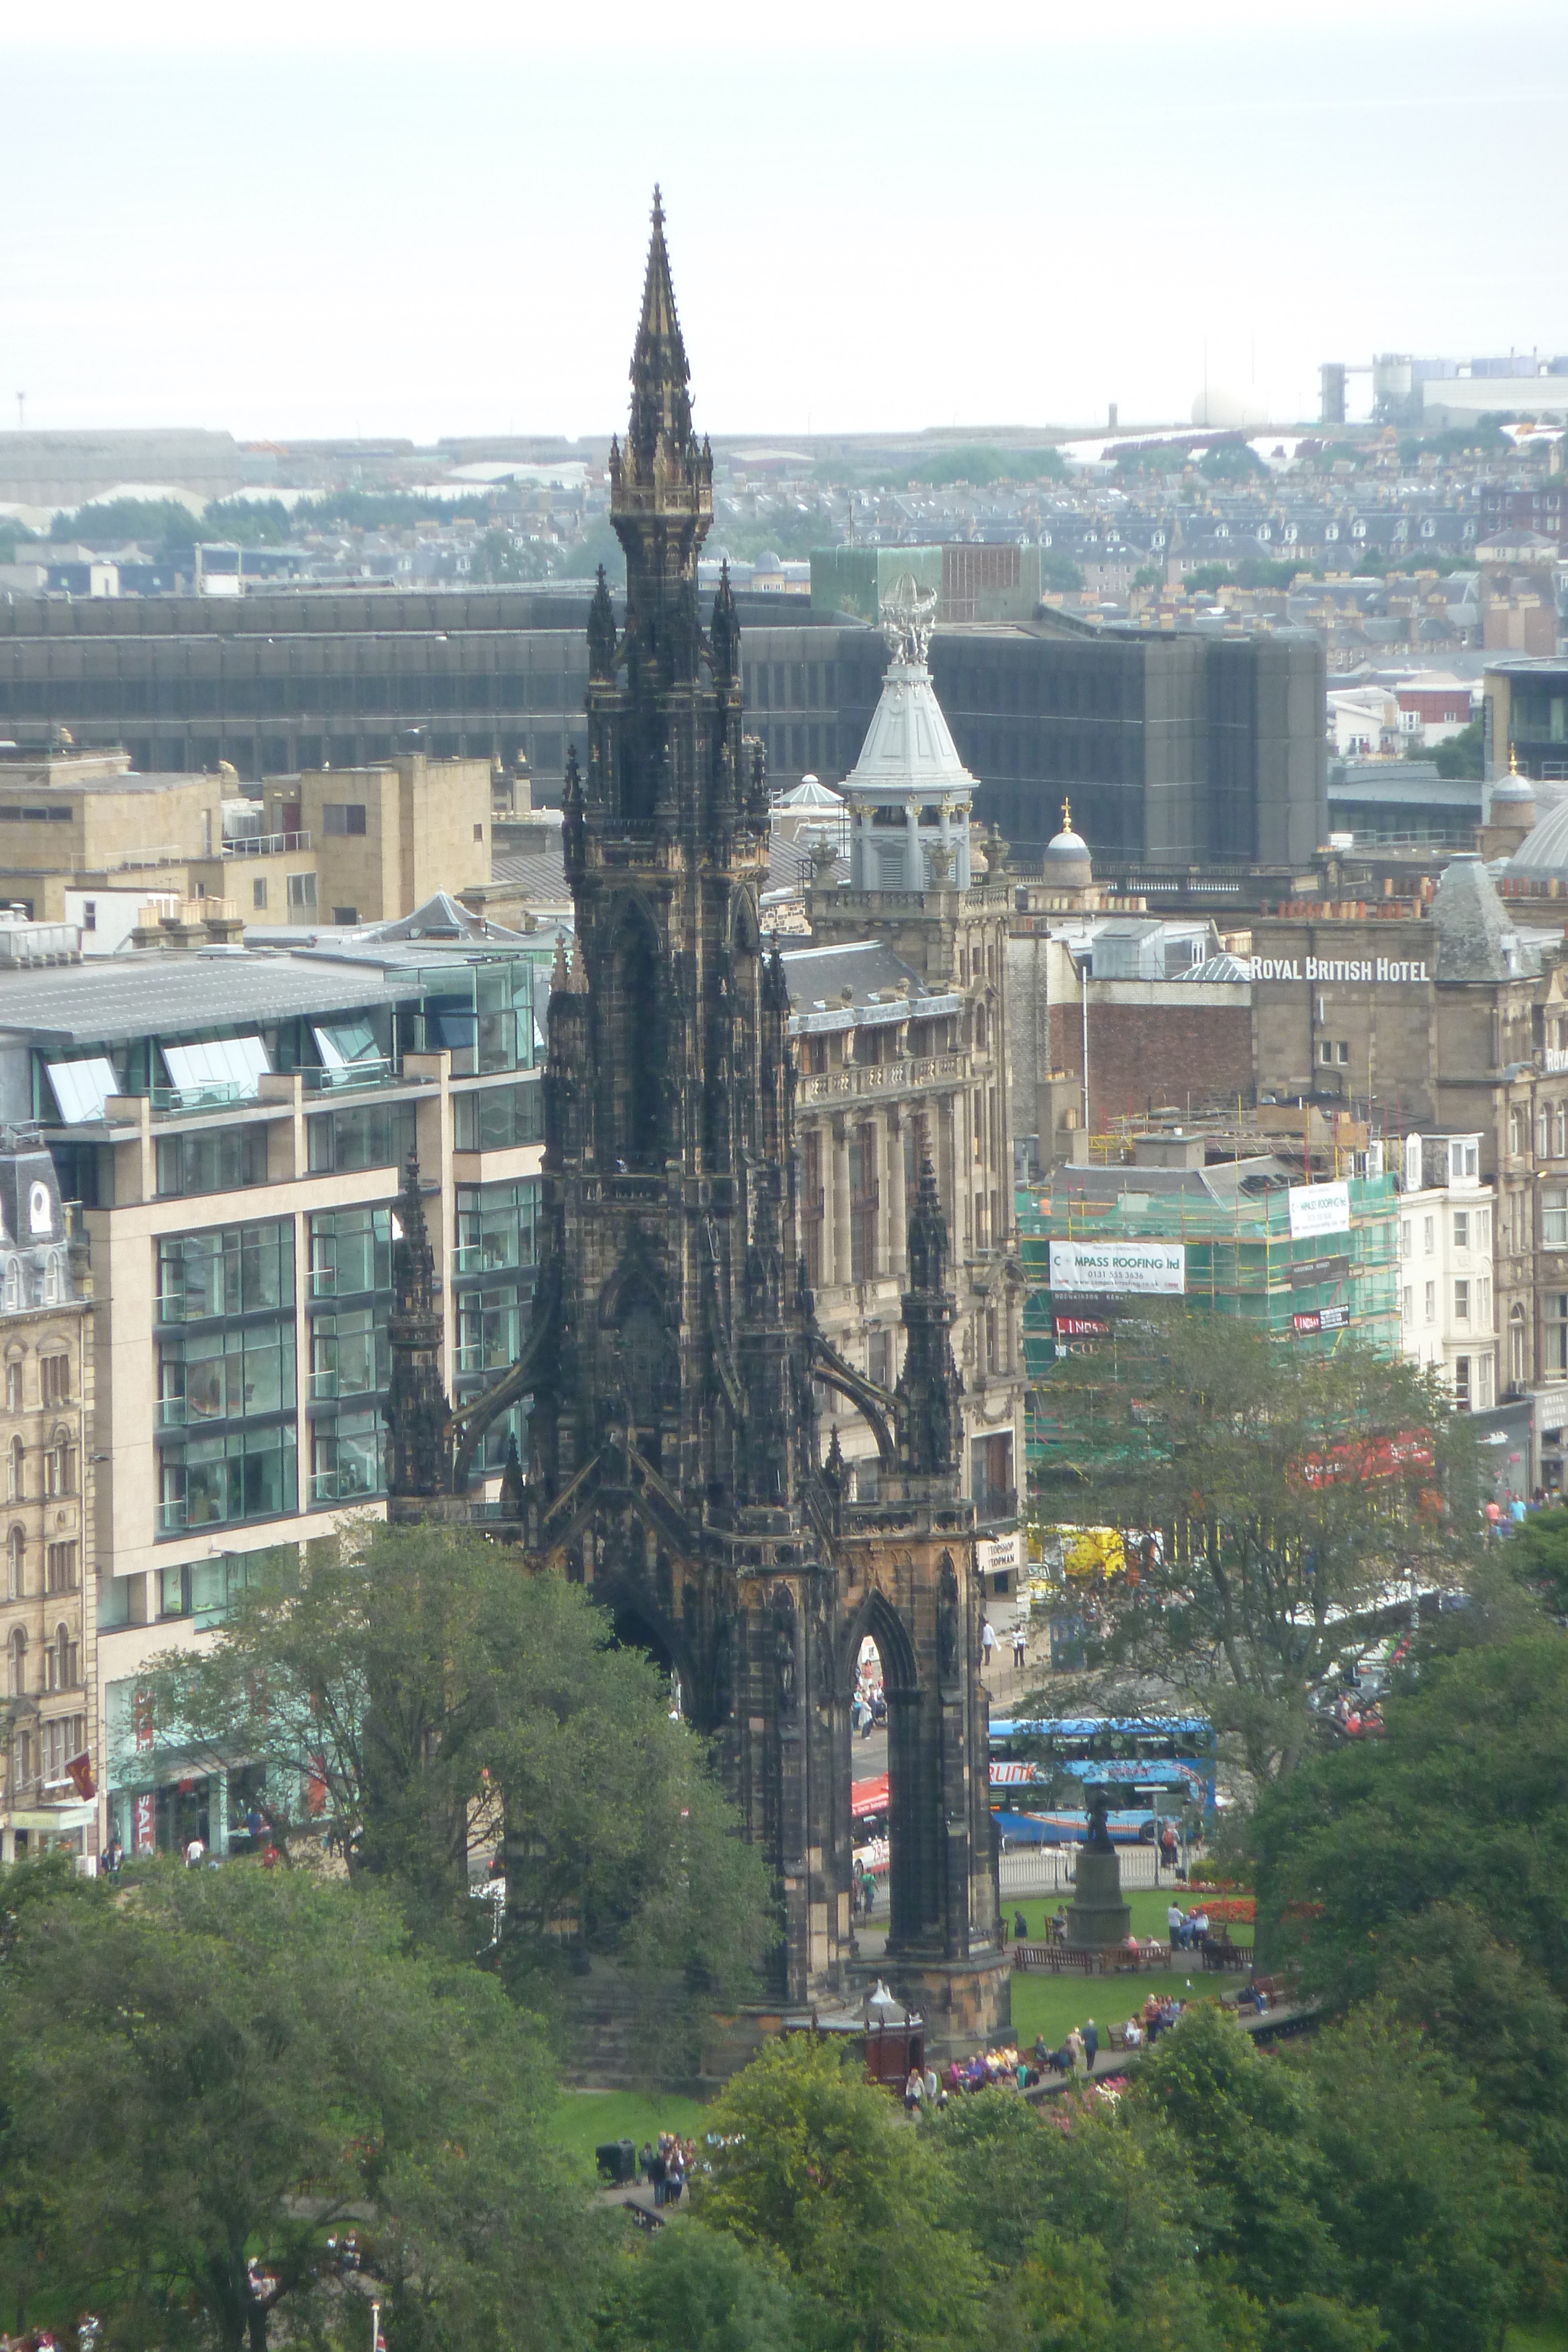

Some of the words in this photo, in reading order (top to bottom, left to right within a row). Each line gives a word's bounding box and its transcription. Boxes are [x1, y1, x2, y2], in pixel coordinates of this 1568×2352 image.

[1251, 956, 1302, 979] ROYAL
[1306, 956, 1372, 980] BRITISH
[1377, 957, 1430, 981] HOTEL
[1113, 1258, 1163, 1269] ROOFING
[1167, 1258, 1179, 1269] ltd
[990, 1541, 1014, 1555] TOPSHOP
[990, 1553, 1014, 1567] TOPMAN
